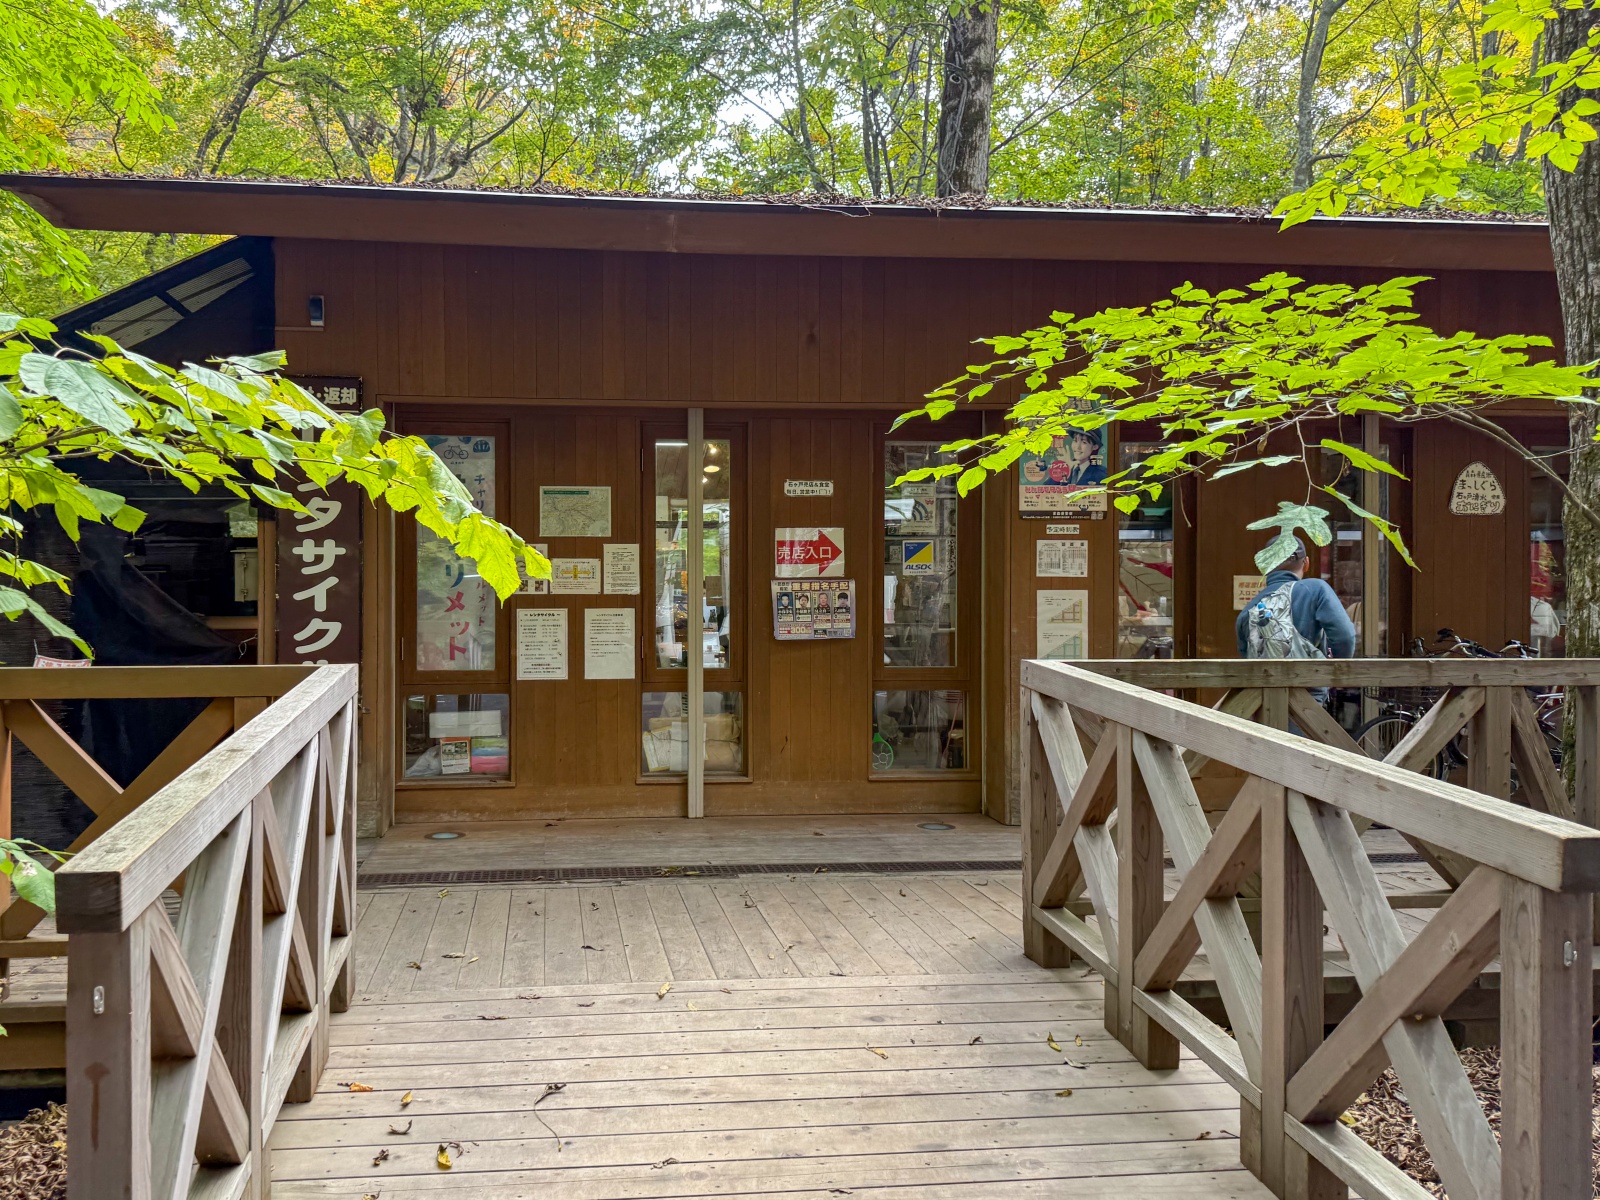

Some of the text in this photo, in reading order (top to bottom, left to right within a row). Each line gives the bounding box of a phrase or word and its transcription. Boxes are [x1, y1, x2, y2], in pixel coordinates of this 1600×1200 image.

[1457, 480, 1497, 491] まっしぐら
[1456, 500, 1500, 512] おにぎり
[778, 546, 831, 560] 売店入口
[791, 581, 850, 591] 重要指名手配
